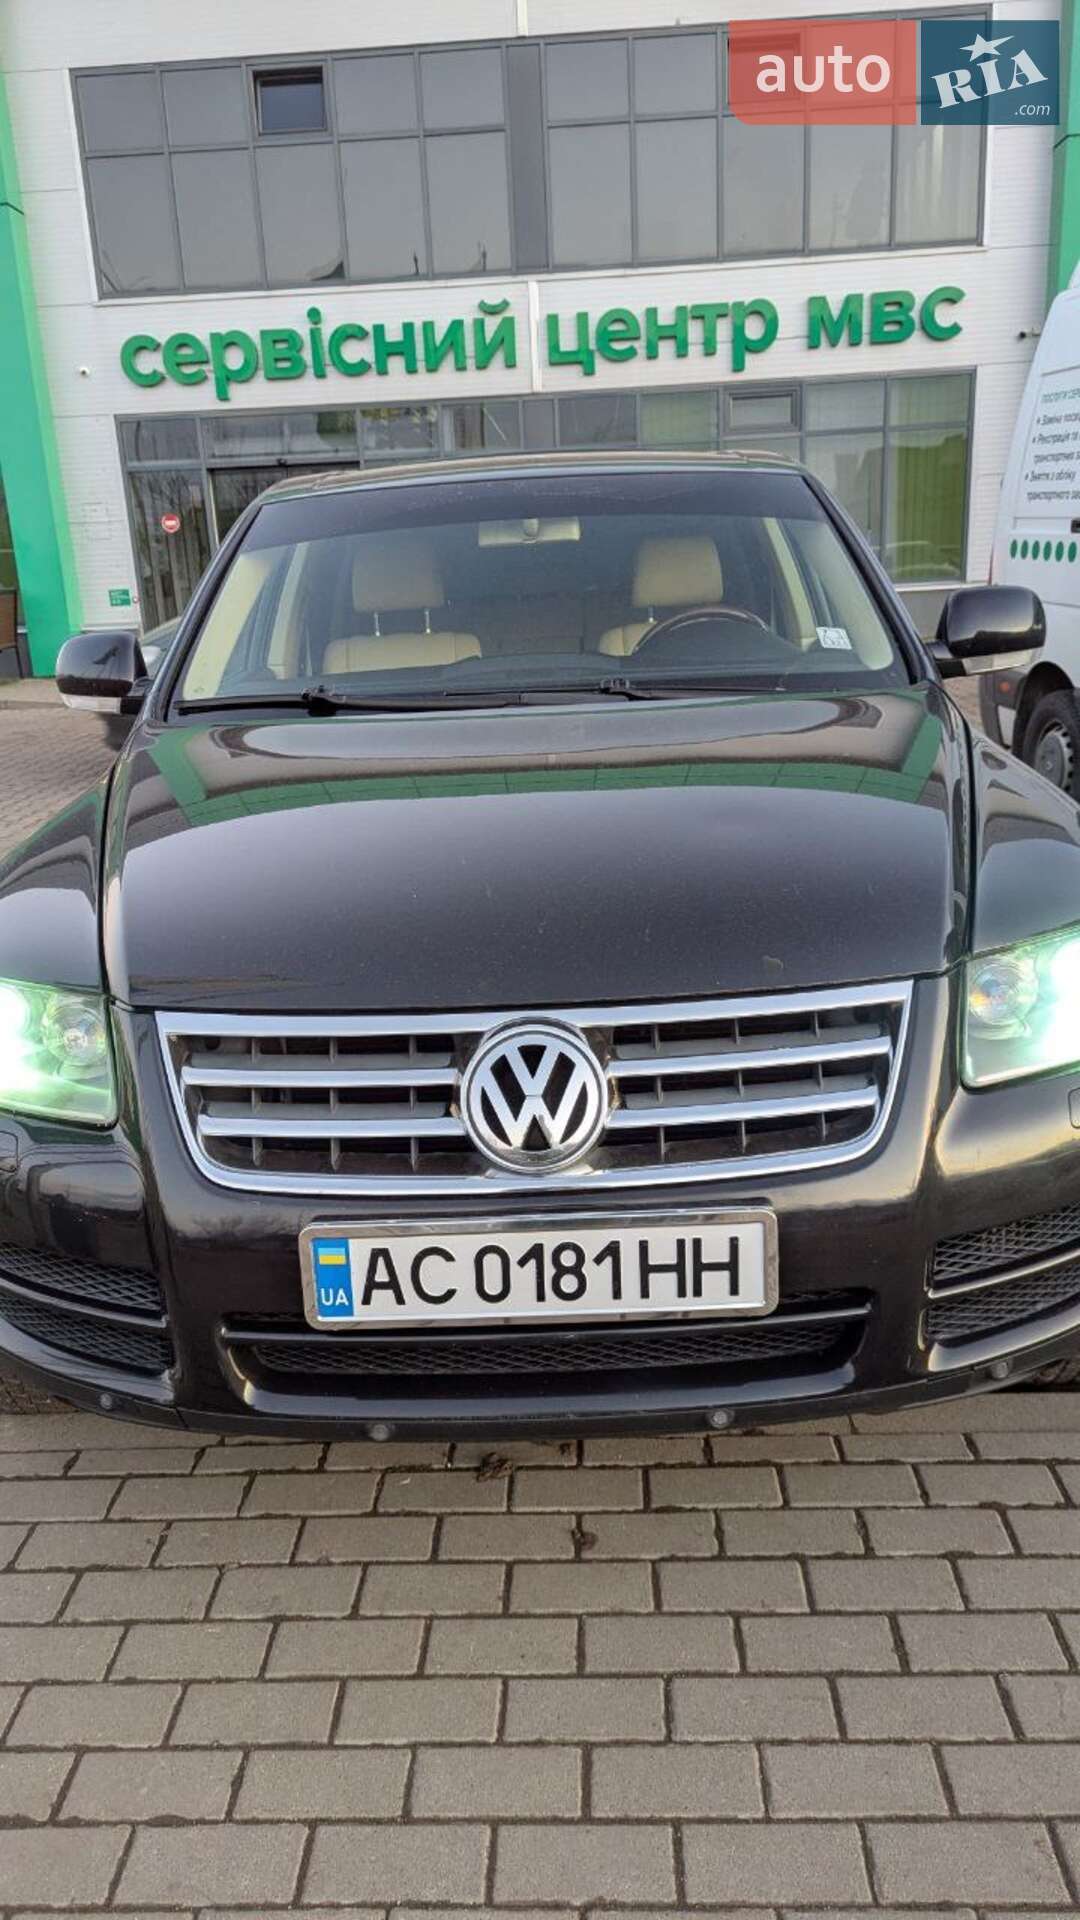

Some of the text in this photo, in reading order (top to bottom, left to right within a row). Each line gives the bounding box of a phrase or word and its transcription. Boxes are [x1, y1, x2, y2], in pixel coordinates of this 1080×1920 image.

[120, 298, 517, 401] сервісний
[546, 298, 779, 376] центр
[320, 1287, 349, 1307] UA
[361, 1236, 740, 1306] AC 0181 HH
